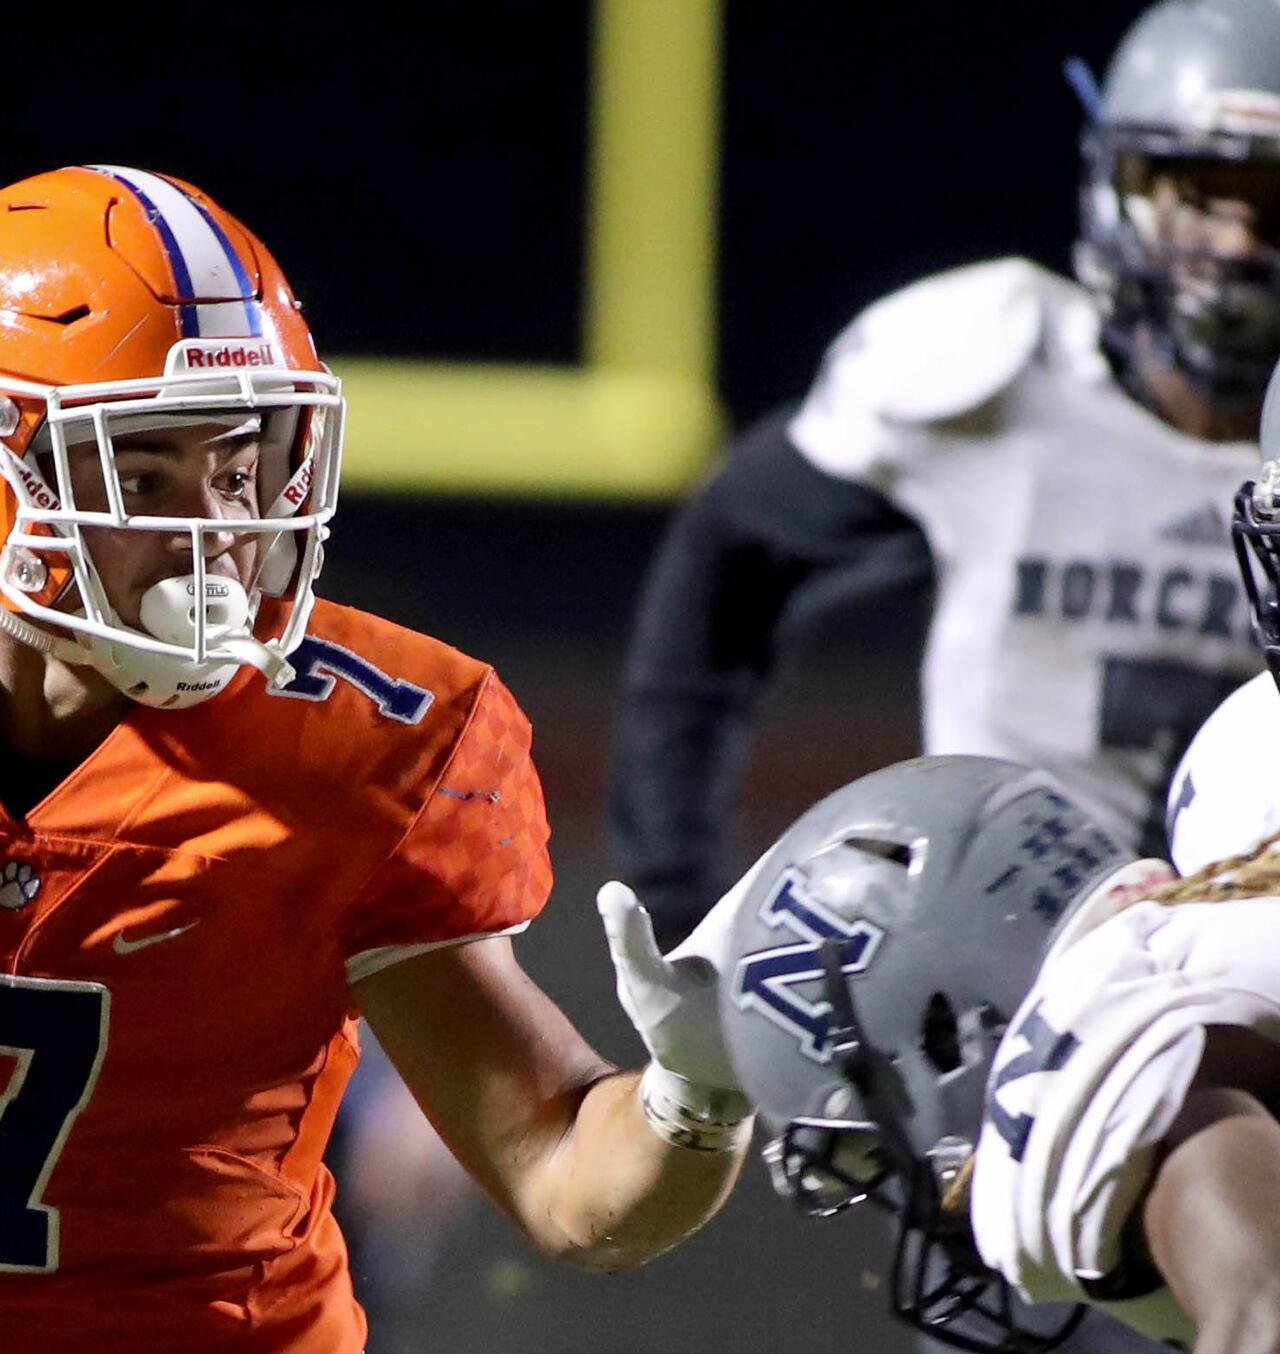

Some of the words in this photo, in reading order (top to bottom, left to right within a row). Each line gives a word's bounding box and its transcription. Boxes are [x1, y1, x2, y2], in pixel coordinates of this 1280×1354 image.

[185, 343, 275, 368] Riddell
[176, 679, 221, 691] Riddell
[265, 633, 436, 725] 7
[730, 864, 884, 1064] N
